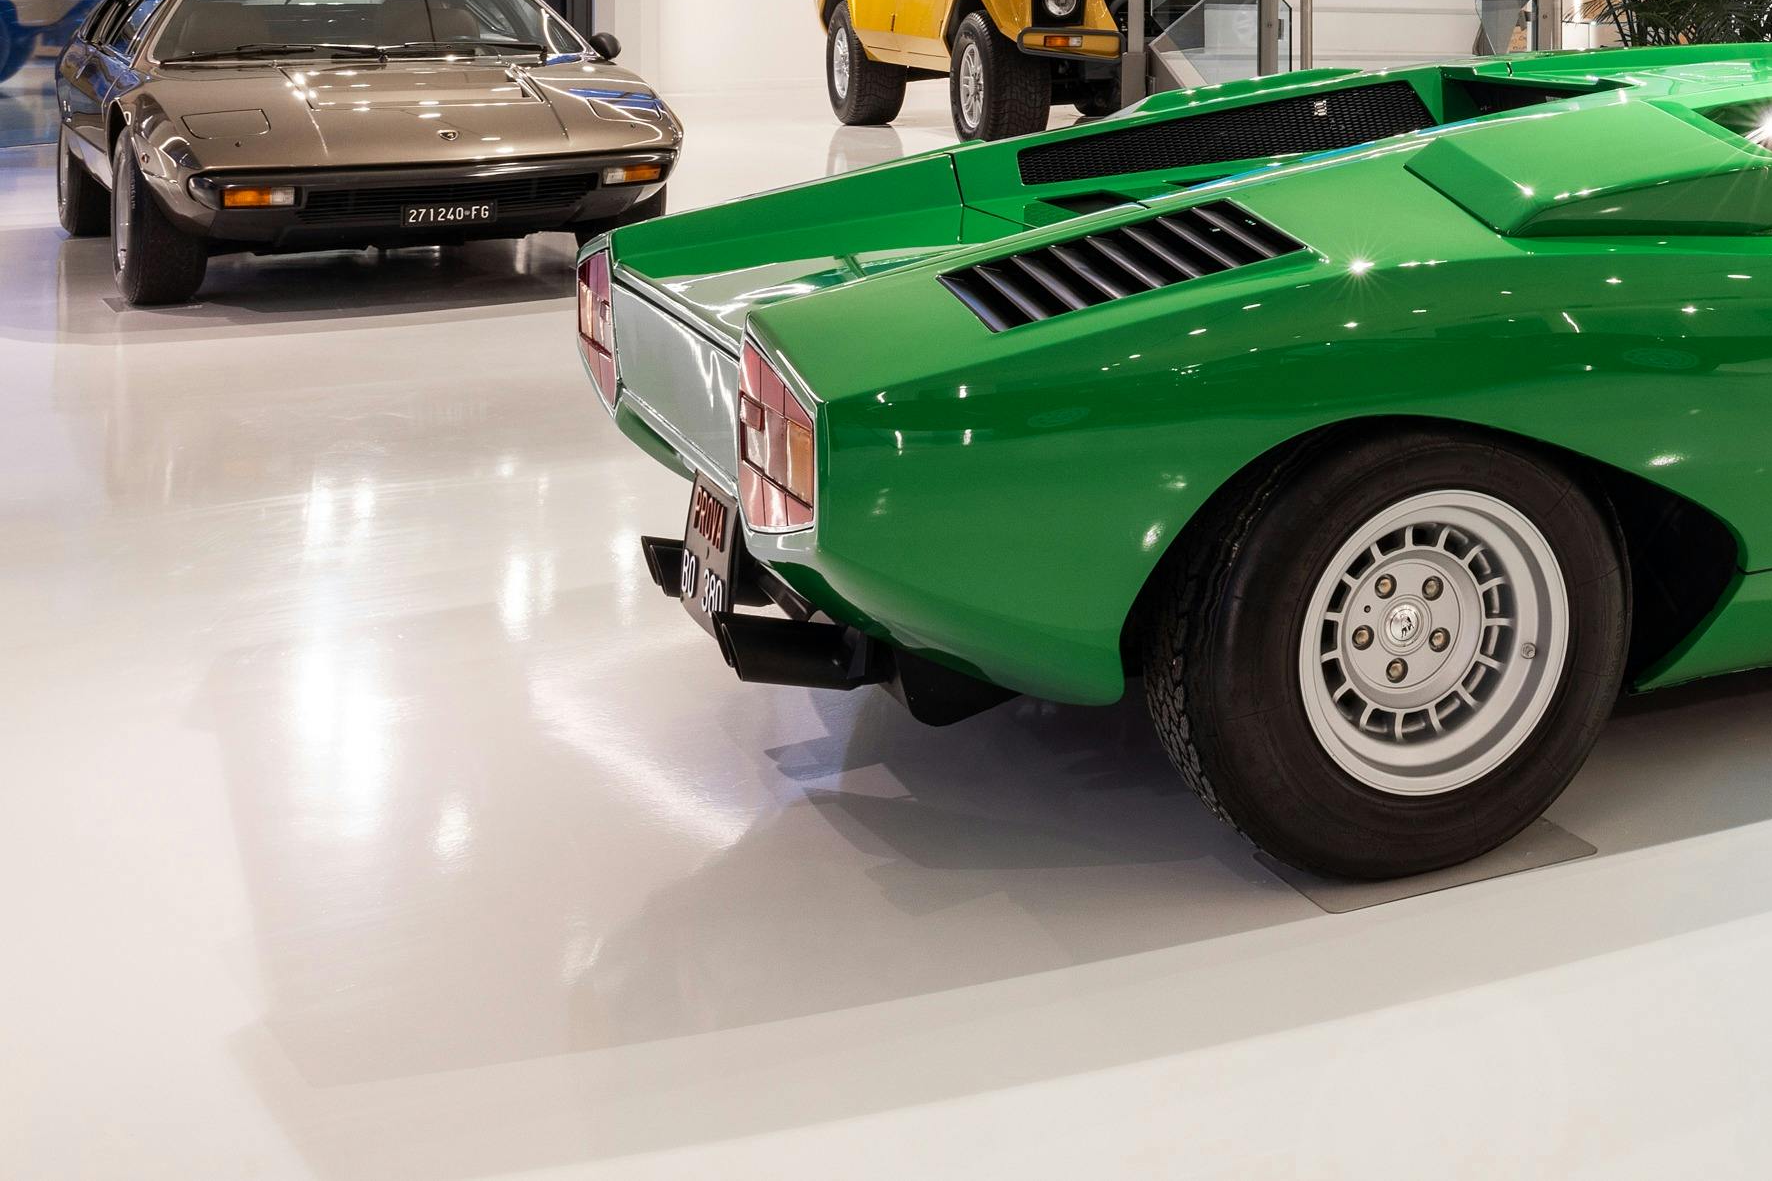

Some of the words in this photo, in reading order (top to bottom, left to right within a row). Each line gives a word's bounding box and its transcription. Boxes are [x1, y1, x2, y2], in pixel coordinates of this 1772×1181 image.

[408, 207, 464, 223] 271240
[471, 205, 490, 219] FG
[693, 485, 728, 554] PROVA
[702, 567, 723, 618] 380
